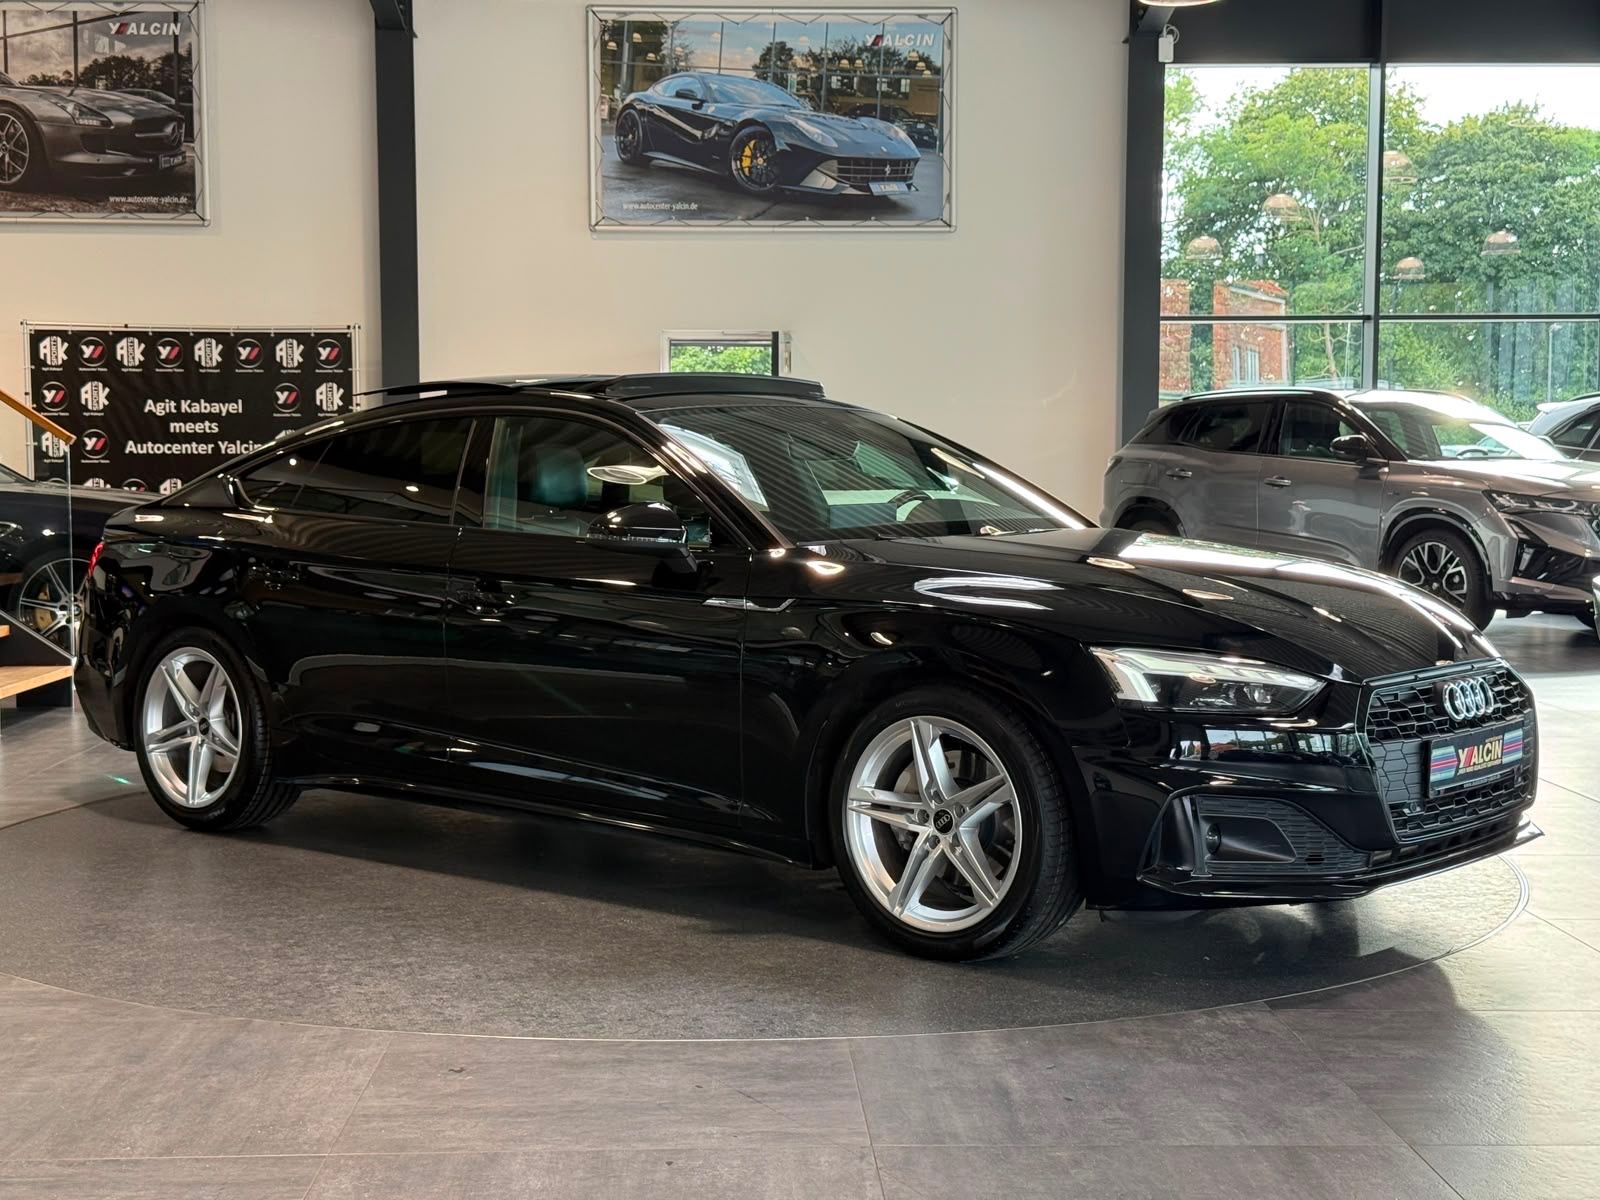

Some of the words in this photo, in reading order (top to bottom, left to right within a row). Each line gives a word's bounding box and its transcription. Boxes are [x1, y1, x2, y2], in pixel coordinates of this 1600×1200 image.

[108, 22, 181, 36] YALCIN
[865, 33, 935, 47] YALCIN
[144, 398, 177, 417] Agit
[180, 398, 243, 417] Kabayel
[169, 420, 219, 433] meets
[125, 440, 215, 455] Autocenter
[1458, 739, 1503, 769] YALCIN
